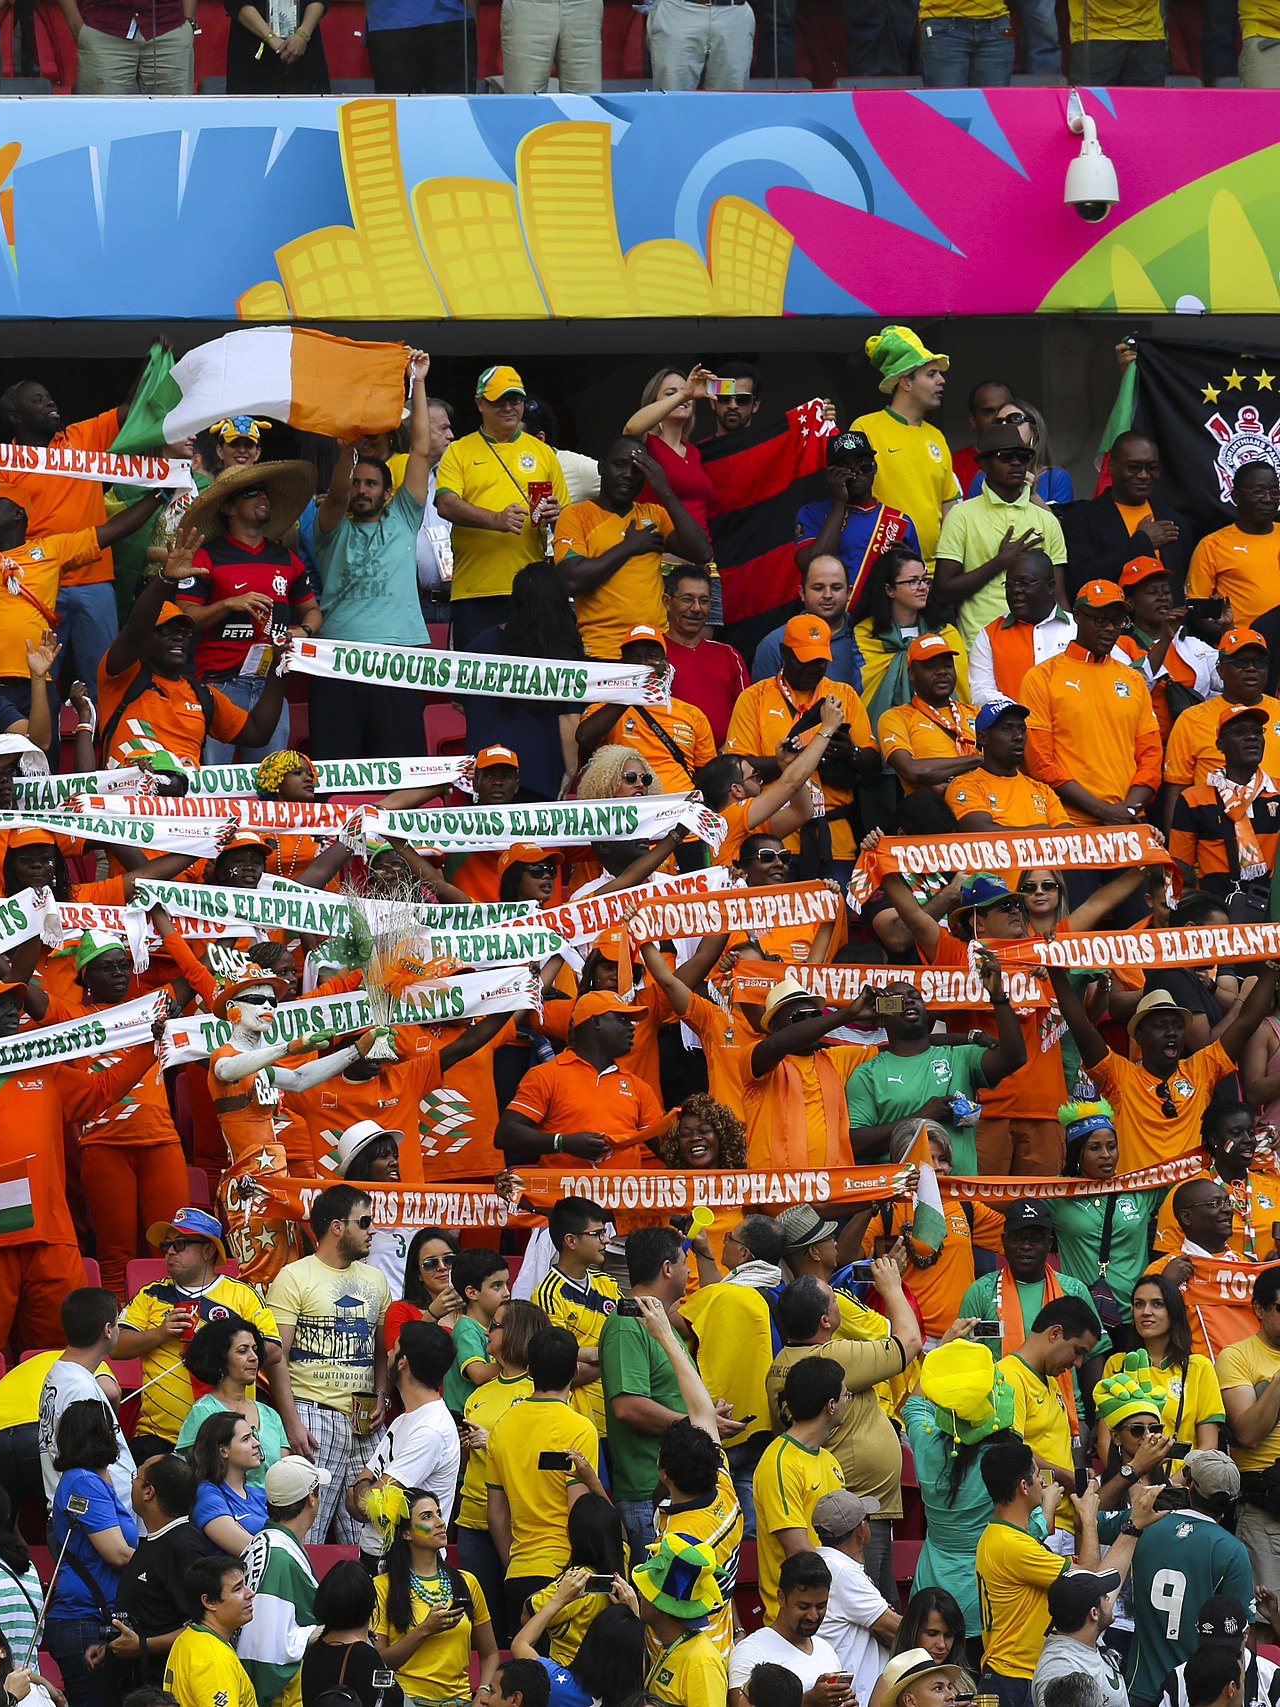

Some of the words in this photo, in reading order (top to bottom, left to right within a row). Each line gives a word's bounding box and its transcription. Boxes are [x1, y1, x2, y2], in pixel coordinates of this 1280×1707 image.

[44, 446, 171, 481] ELEPHANTS
[222, 628, 254, 639] PETR
[332, 646, 451, 687] TOUJOURS
[454, 659, 589, 699] ELEPHANTS
[11, 776, 99, 812] PHANTS
[316, 765, 402, 792] PHANTS
[387, 811, 504, 836] TOUJOURS
[510, 804, 639, 837] ELEPHANTS
[890, 839, 1011, 874] TOUJOURS
[1015, 830, 1143, 869] ELEPHANTS
[631, 902, 723, 941] OUJOURS
[727, 888, 837, 931] ELEPHANT
[432, 930, 563, 963] ELEPHANTS
[1033, 933, 1154, 969] TOUJOURS
[560, 1175, 688, 1209] TOUJOURS
[691, 1171, 831, 1206] ELEPHANTS
[853, 1180, 879, 1189] CNSE
[402, 1192, 509, 1228] ELEPHANTS
[312, 1371, 361, 1380] HUNTINGTON
[1150, 1567, 1187, 1641] 9
